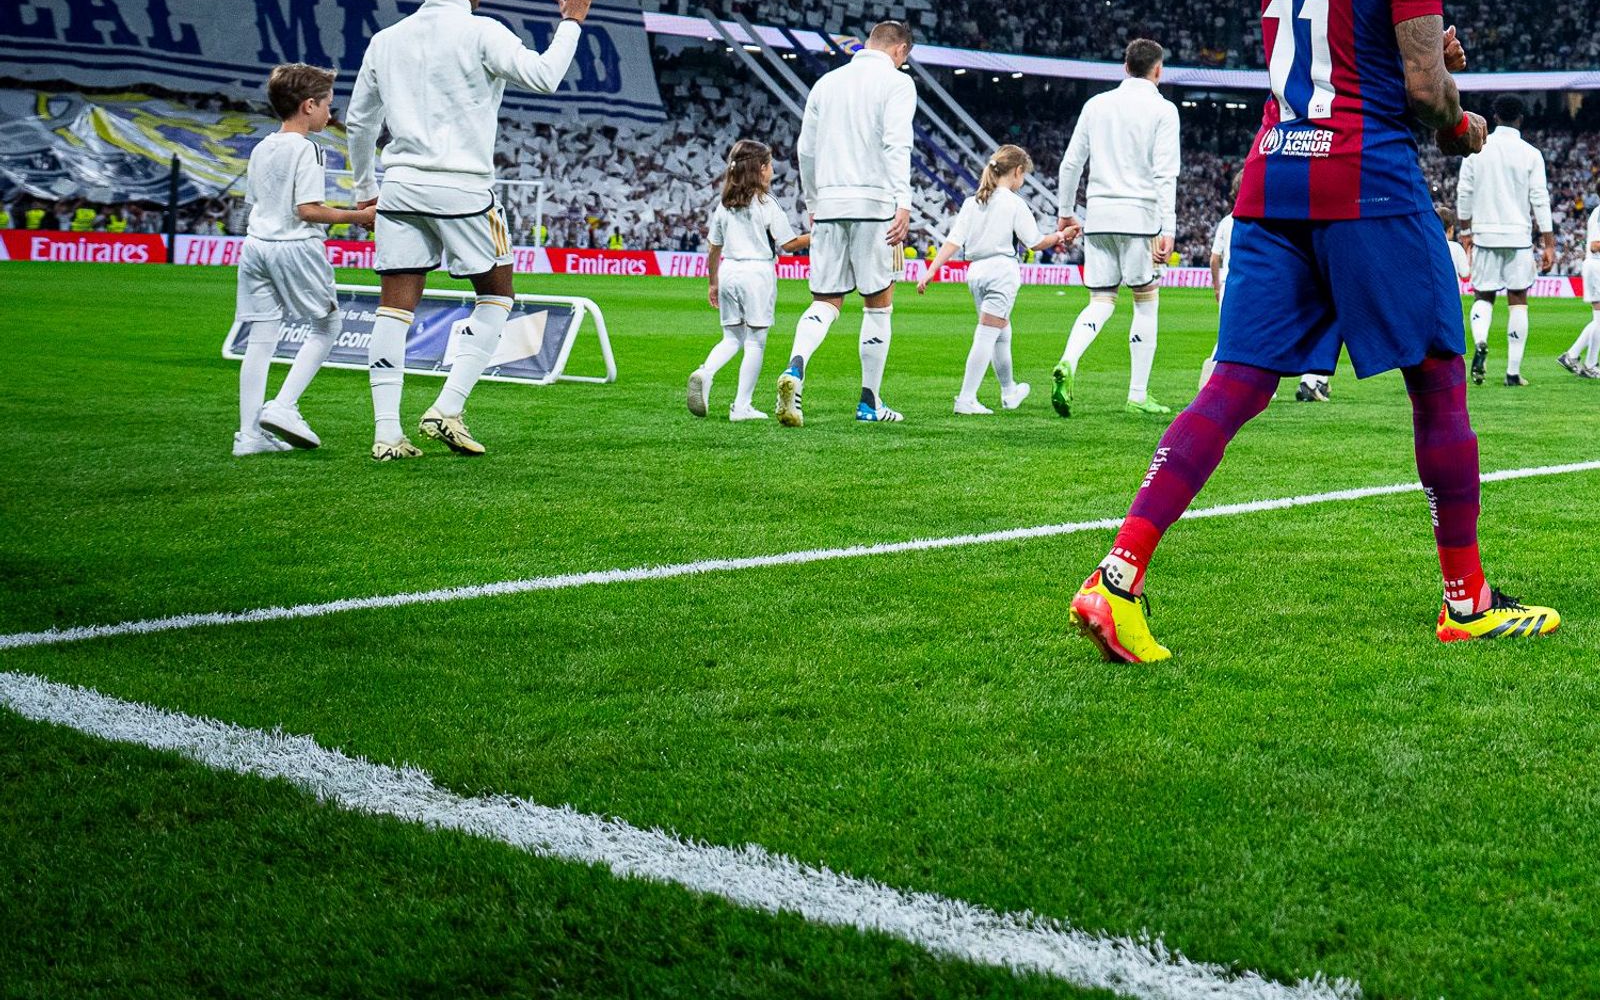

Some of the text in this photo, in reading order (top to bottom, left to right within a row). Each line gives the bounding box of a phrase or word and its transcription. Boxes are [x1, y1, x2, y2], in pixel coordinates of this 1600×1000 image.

[1282, 140, 1332, 153] ACNUR
[1285, 129, 1334, 142] UNHCR
[30, 236, 149, 263] Emirates
[186, 239, 218, 265] FLY
[566, 253, 647, 275] Emirates
[670, 255, 694, 277] FLY
[1177, 270, 1212, 288] BETTE
[1141, 446, 1171, 489] BARÇA
[1423, 485, 1440, 528] BARÇA
